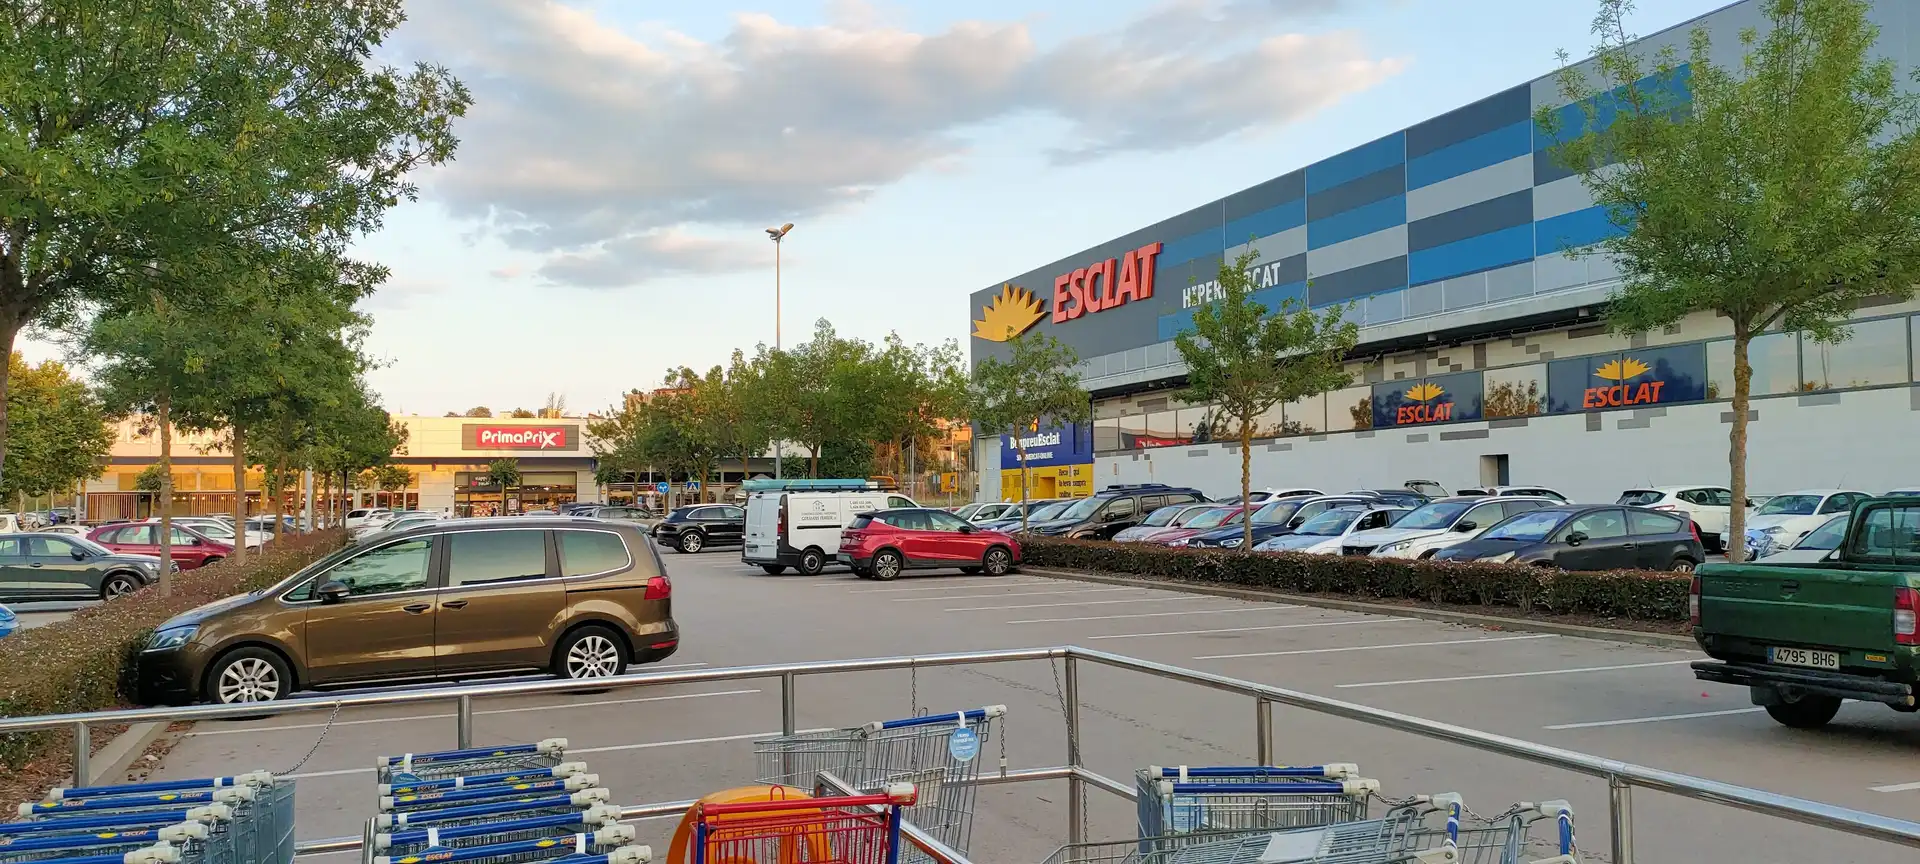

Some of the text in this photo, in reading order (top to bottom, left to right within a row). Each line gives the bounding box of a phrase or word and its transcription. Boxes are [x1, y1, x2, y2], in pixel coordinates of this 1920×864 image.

[1052, 241, 1163, 325] ESCLAT
[1182, 262, 1280, 308] HIPERRCAT
[1583, 381, 1664, 408] ESCLAT
[1397, 402, 1455, 424] ESCLAT
[1776, 648, 1835, 667] 4795 BHG
[425, 852, 454, 860] ESCLAT
